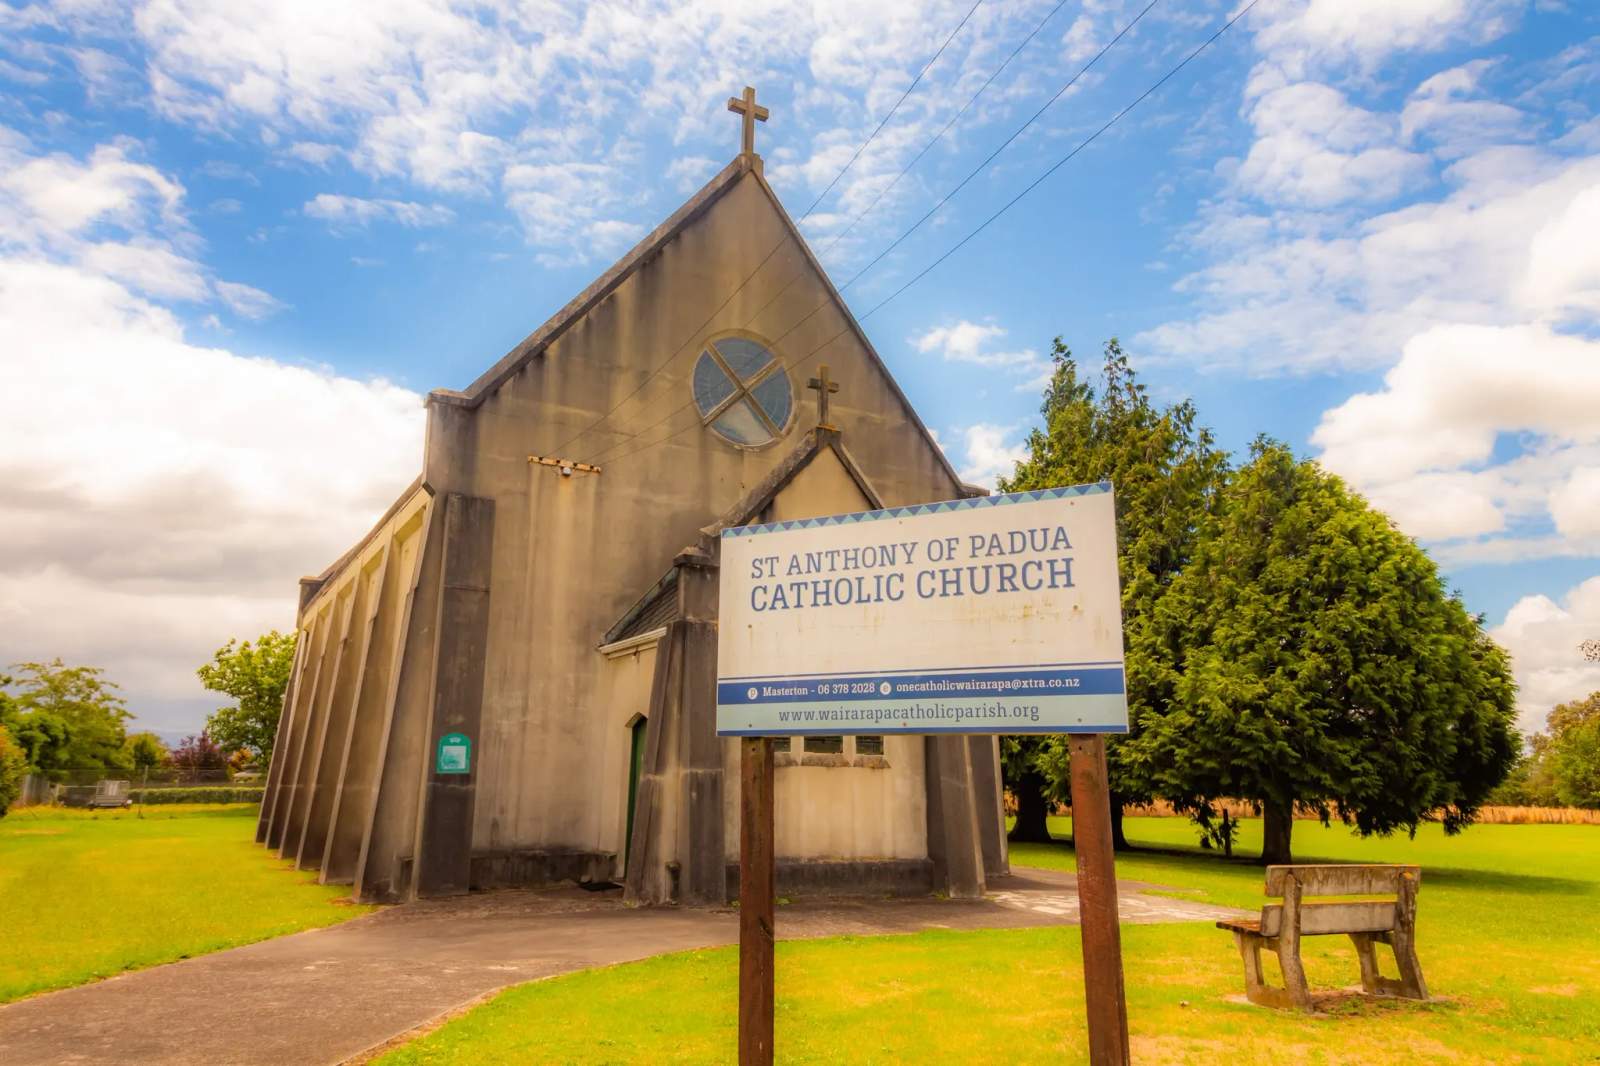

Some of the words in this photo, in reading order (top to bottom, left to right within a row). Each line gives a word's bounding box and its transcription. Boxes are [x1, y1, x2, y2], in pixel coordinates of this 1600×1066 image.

[751, 556, 779, 579] ST
[786, 542, 919, 576] ANTHONY
[927, 537, 959, 562] OF
[969, 526, 1073, 558] PADUA
[751, 573, 904, 612] CATHOLIC
[916, 557, 1075, 599] CHURCH
[763, 686, 808, 697] Masterton
[818, 684, 830, 695] 06
[832, 683, 849, 694] 378
[851, 682, 876, 694] 2028
[896, 678, 1080, 693] onecatholicwairarapa@xtra.co.nz
[778, 702, 1040, 723] www.wairarapacatholicparish.org
